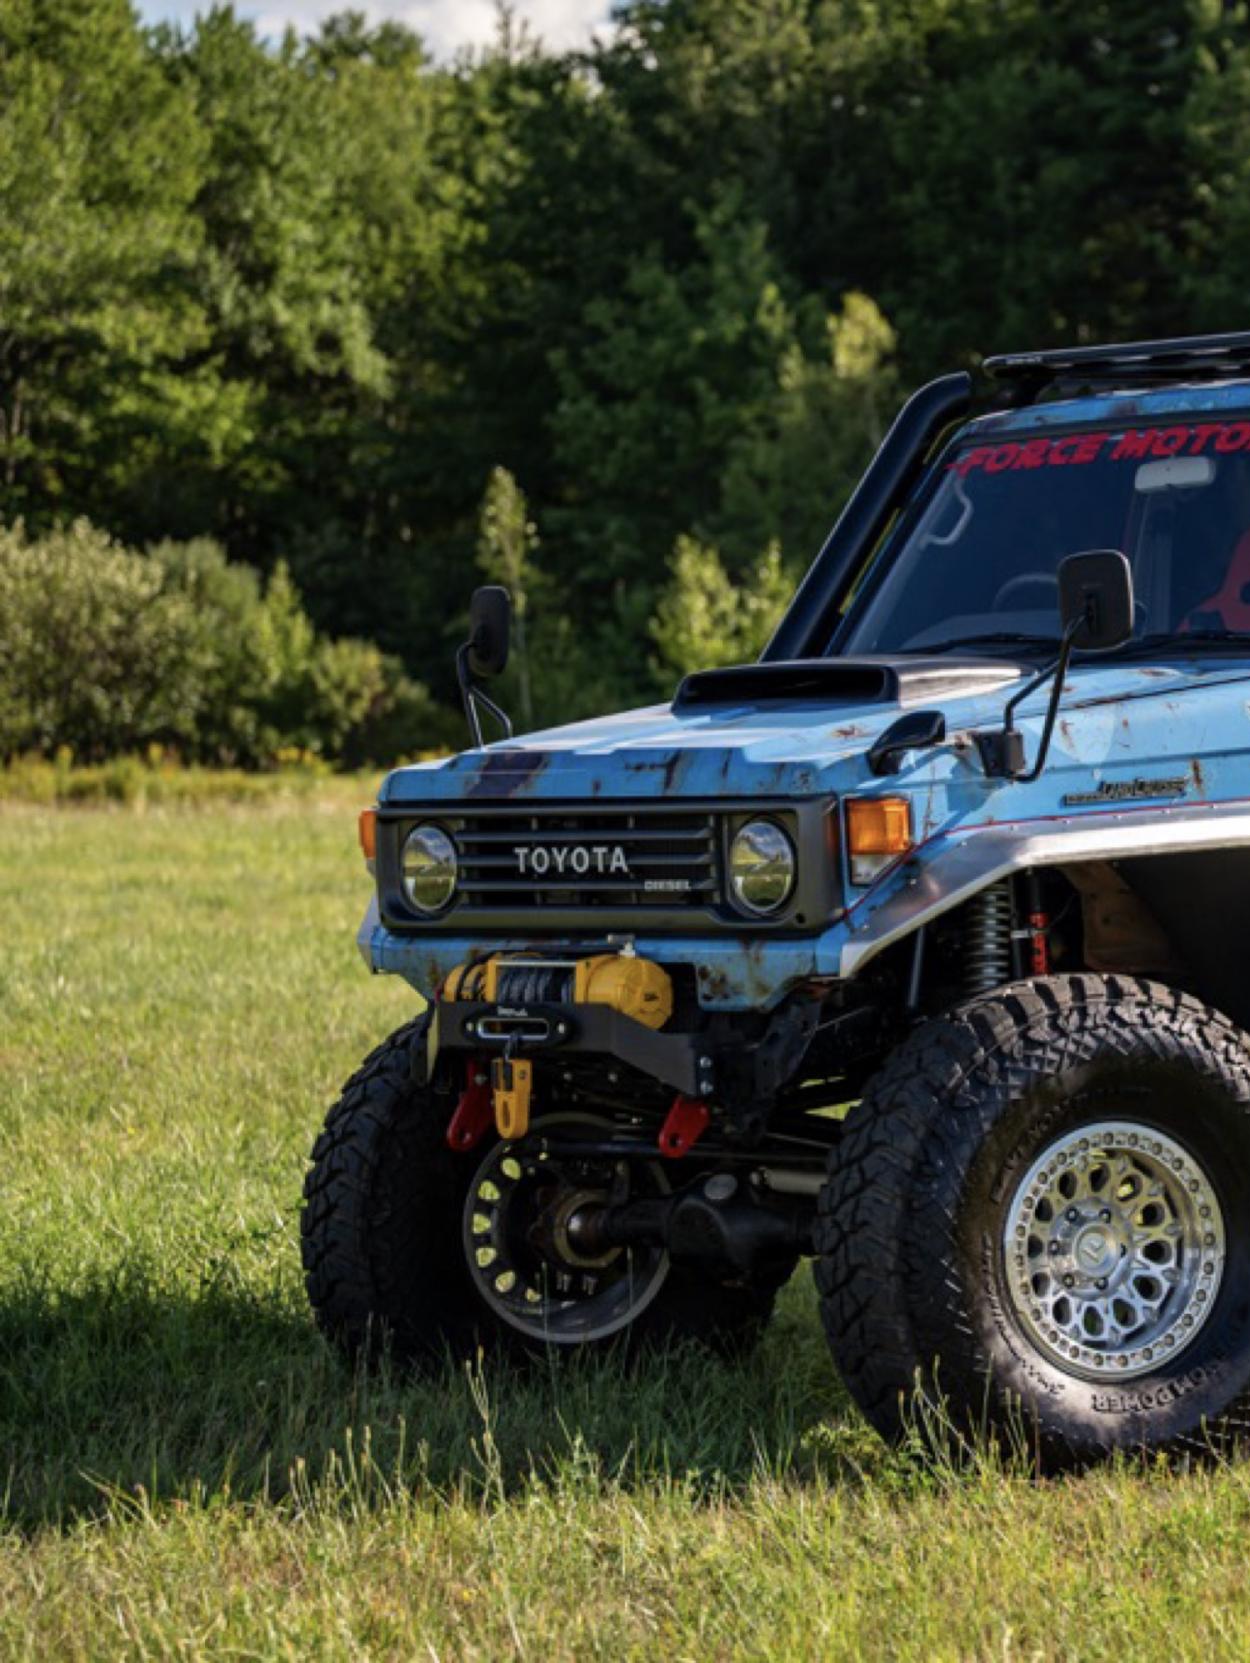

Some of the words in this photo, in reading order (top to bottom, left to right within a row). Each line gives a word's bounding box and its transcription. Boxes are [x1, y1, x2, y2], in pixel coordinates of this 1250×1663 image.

[950, 433, 1109, 478] FORCE
[513, 846, 629, 873] TOYOTA
[644, 879, 692, 891] DIESEL
